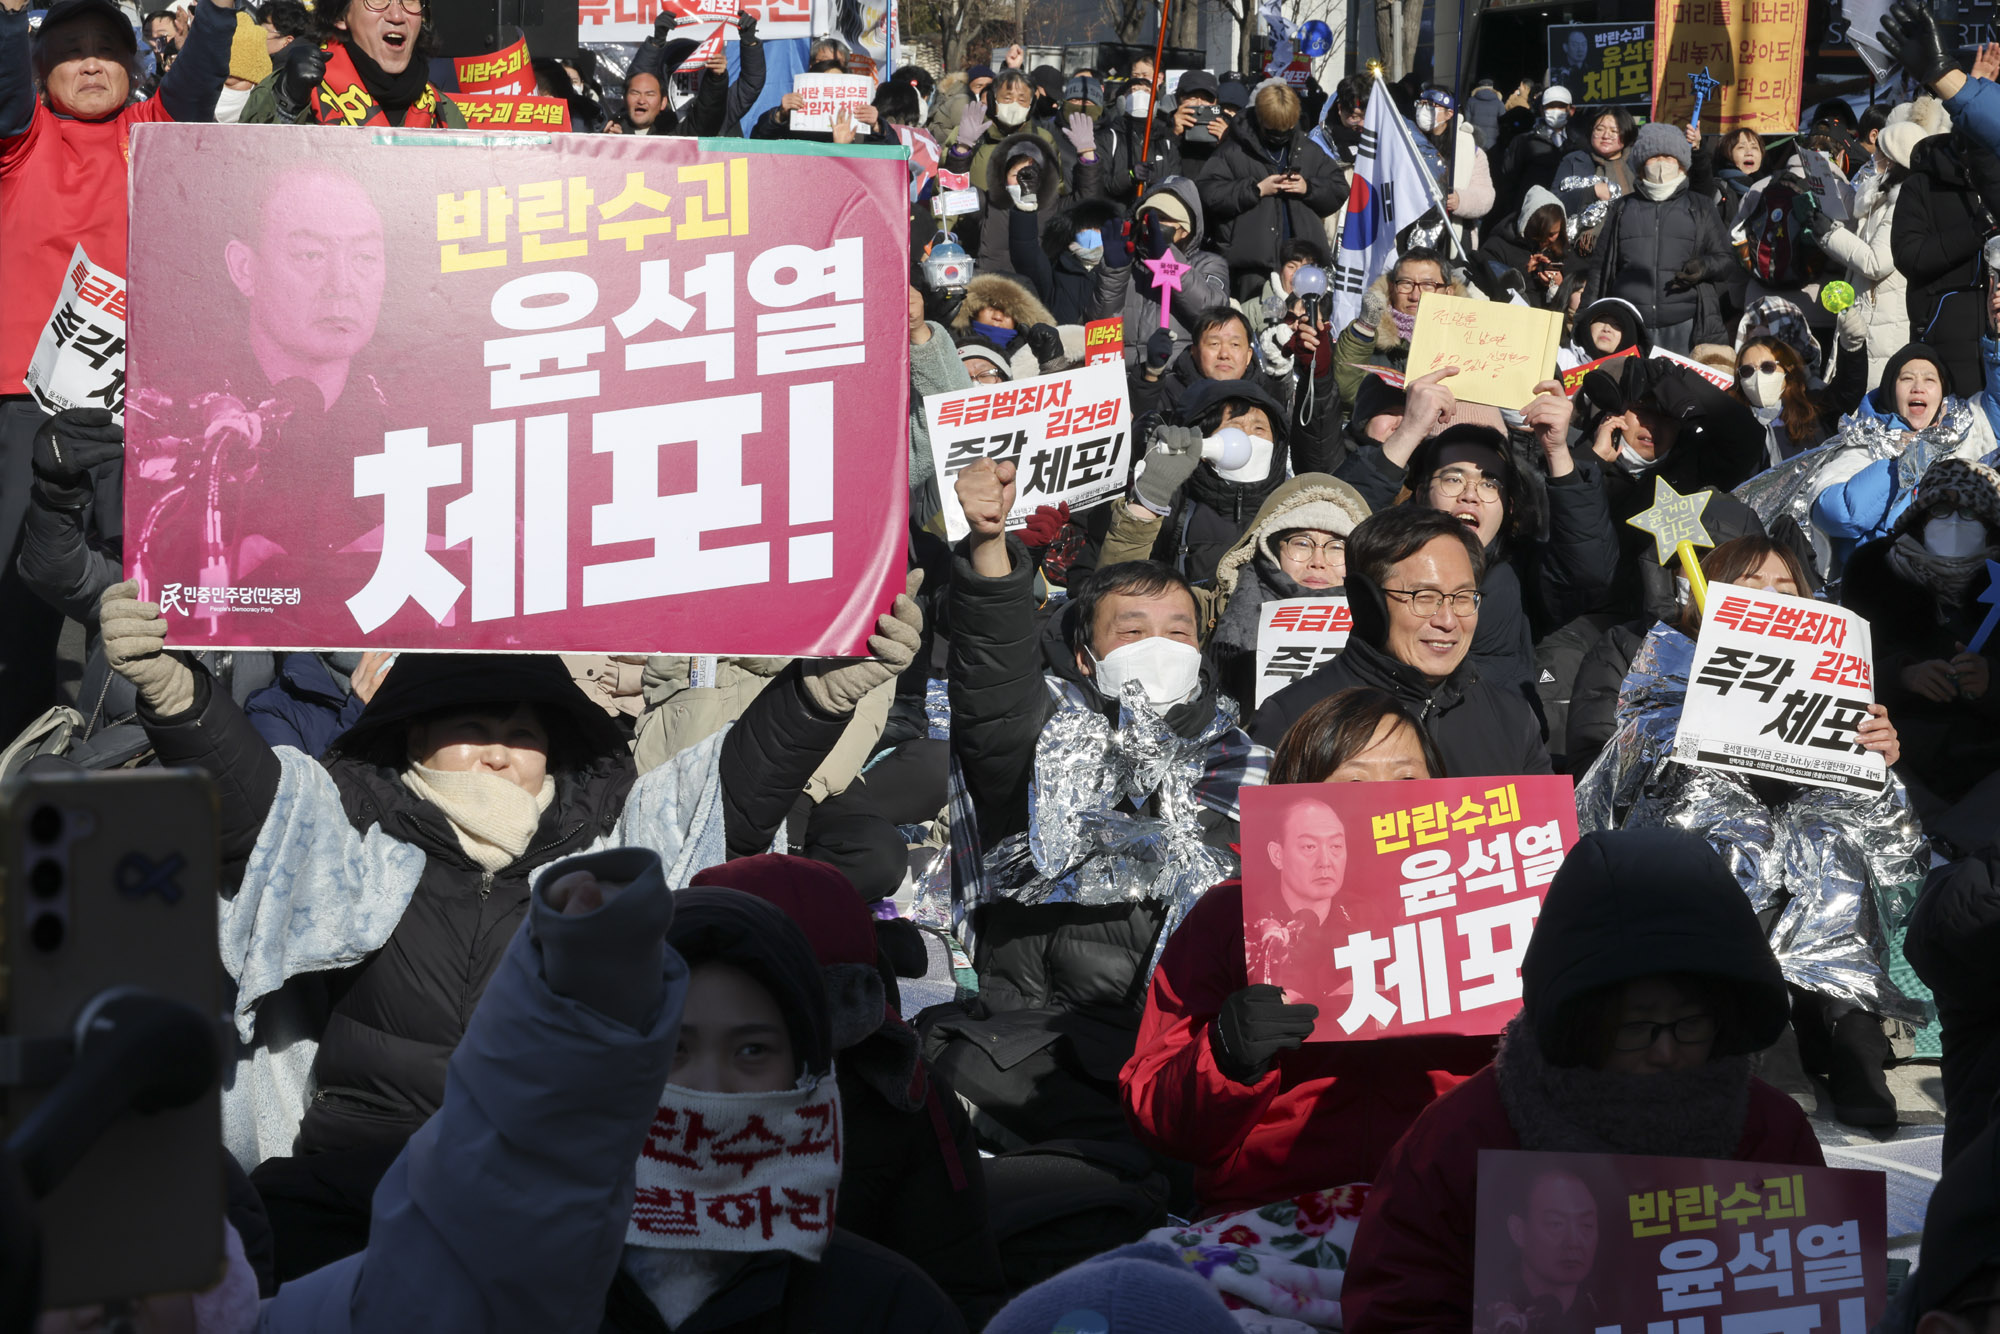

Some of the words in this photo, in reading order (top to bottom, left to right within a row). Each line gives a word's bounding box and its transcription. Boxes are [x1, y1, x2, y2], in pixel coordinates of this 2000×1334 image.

[1672, 1, 1731, 26] 머리를
[1742, 2, 1795, 24] 내놔라
[1595, 25, 1645, 48] 반란수괴
[1669, 41, 1730, 65] 내놓지
[1739, 39, 1791, 65] 않아도
[460, 49, 522, 83] 내란수괴
[823, 86, 868, 99] 특검으로
[1668, 79, 1730, 102] 구서
[1737, 77, 1787, 103] 먹으리
[453, 102, 512, 124] 란수괴
[515, 102, 564, 125] 윤석열
[437, 157, 749, 274] 반란수괴
[484, 236, 866, 410] 윤석열
[937, 379, 1072, 427] 특급범죄자
[1045, 397, 1122, 440] 김건희
[1022, 432, 1126, 498] 체포!
[345, 380, 834, 635] 체포!
[1661, 517, 1696, 545] 타도
[183, 587, 301, 605] 민중민주당(민중당)
[232, 606, 260, 614] Democracy
[1713, 596, 1847, 649] 특급범죄자
[1810, 650, 1872, 692] 김건희
[1695, 646, 1795, 704] 즉각
[1758, 689, 1871, 756] 체포
[1723, 743, 1741, 753] 윤석열
[1743, 746, 1772, 760] 탄핵기금
[1773, 753, 1789, 763] 모금
[1371, 783, 1521, 855] 반란수괴
[1399, 820, 1566, 917] 윤석열
[1333, 895, 1543, 1035] 체포
[1628, 1174, 1806, 1239] 반란수괴
[1657, 1219, 1864, 1312] 윤석열
